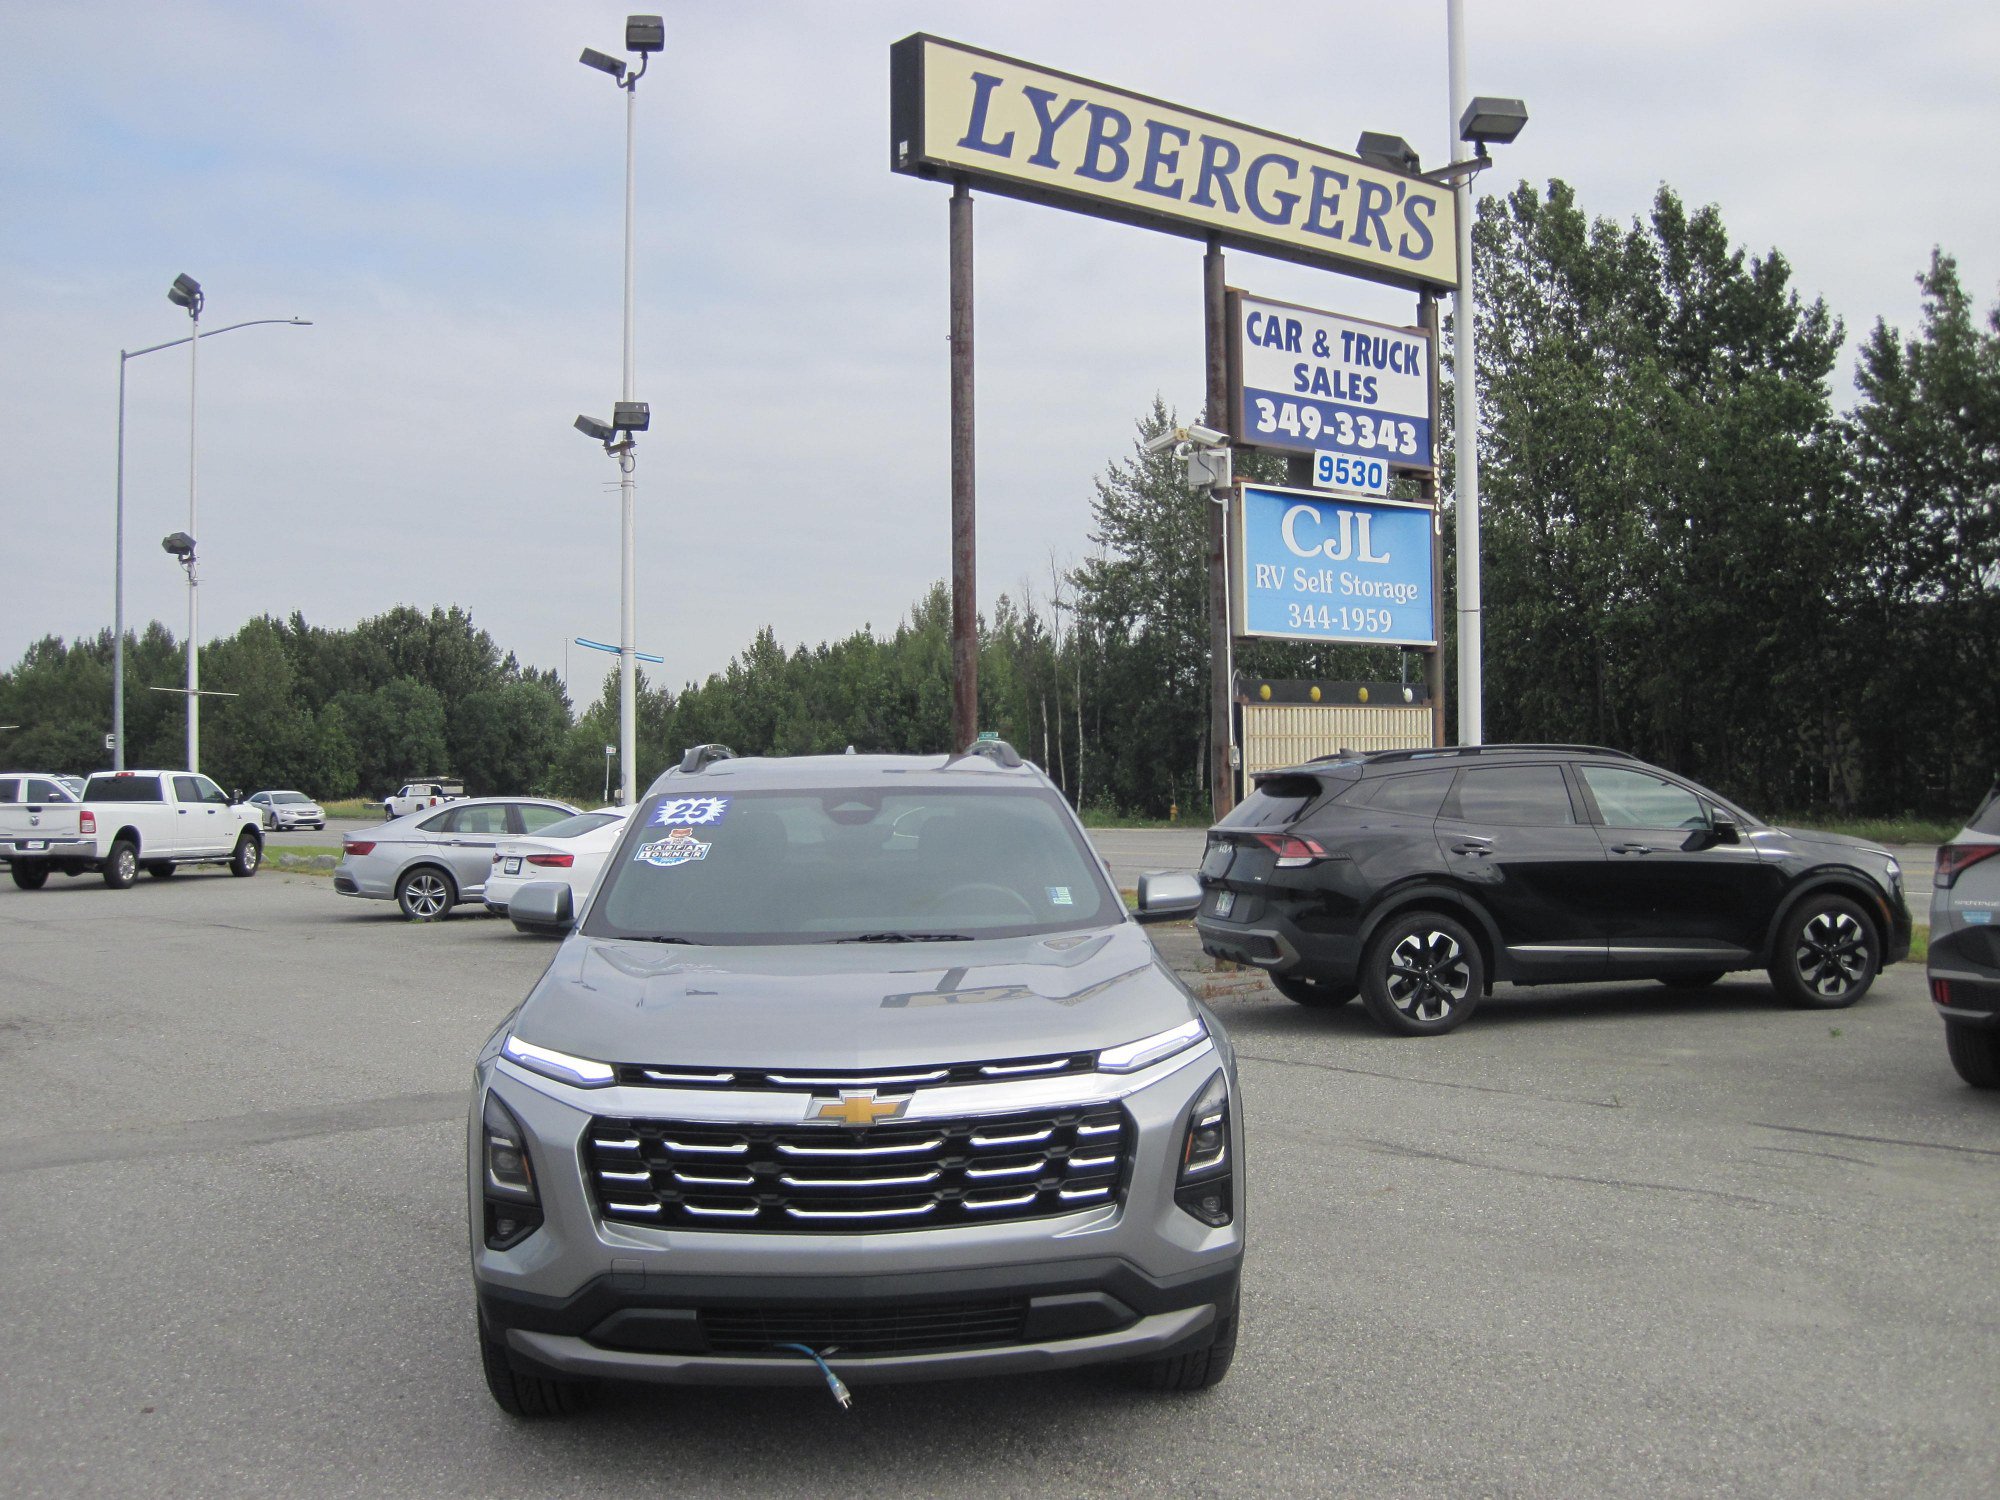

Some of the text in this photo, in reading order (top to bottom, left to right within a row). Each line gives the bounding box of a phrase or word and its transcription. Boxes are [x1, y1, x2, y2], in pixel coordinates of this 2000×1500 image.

[957, 71, 1437, 261] LYBERGER'S
[1246, 311, 1420, 376] CAR & TRUCK
[1294, 362, 1378, 405] SALES
[1255, 398, 1417, 455] 349-3343
[1318, 455, 1383, 489] 9530
[1281, 504, 1391, 564] CJL
[1256, 563, 1418, 604] RV Self Storage
[1288, 603, 1392, 633] 344-1959
[668, 802, 712, 819] 25
[644, 844, 705, 852] CARFAX
